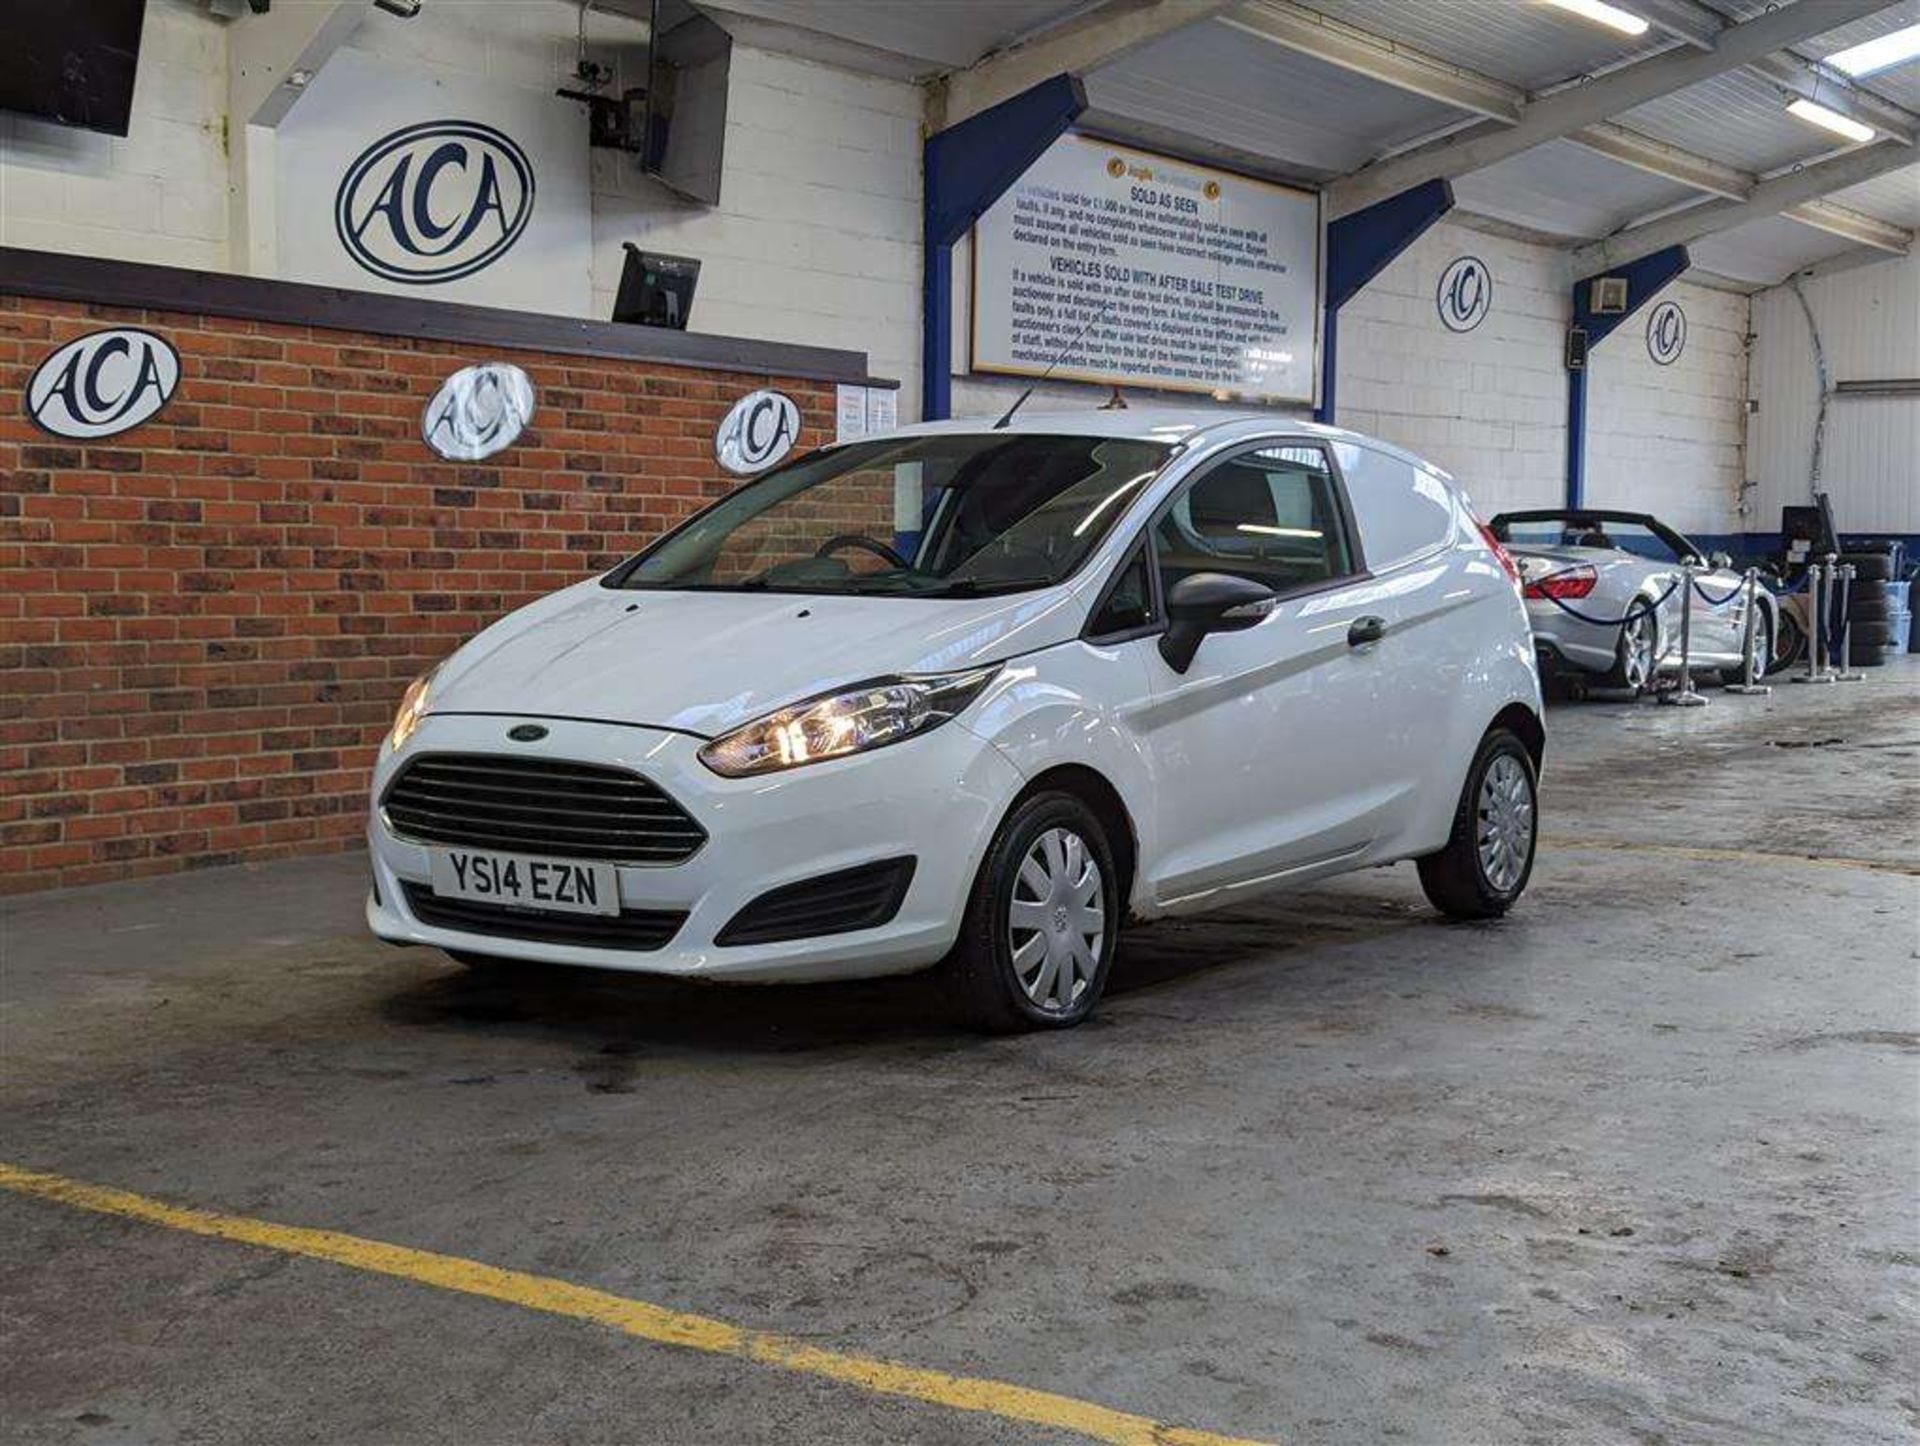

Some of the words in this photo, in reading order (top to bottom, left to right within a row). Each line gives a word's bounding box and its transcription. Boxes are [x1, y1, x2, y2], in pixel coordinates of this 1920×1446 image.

[354, 142, 509, 257] ACA
[1068, 209, 1083, 220] and
[1097, 215, 1136, 232] complaints
[1130, 186, 1156, 205] SOLD
[1159, 192, 1172, 208] AS
[1174, 195, 1198, 213] SEEN
[1013, 229, 1048, 245] declared
[1062, 238, 1074, 249] the
[1076, 240, 1096, 255] entry
[1014, 214, 1033, 226] must
[1036, 220, 1066, 232] assume
[1068, 225, 1078, 234] all
[1080, 227, 1111, 240] vehicles
[1012, 286, 1055, 301] auctioneer
[1057, 293, 1071, 303] and
[1118, 302, 1130, 312] the
[1131, 304, 1149, 317] entry
[1027, 272, 1055, 285] vehicle
[1066, 278, 1083, 290] sold
[1086, 281, 1101, 292] with
[1114, 286, 1130, 297] after
[1132, 289, 1146, 299] sale
[1148, 291, 1161, 301] test
[1050, 256, 1101, 278] VEHICLES
[1103, 265, 1130, 282] SOLD
[1132, 270, 1156, 287] WITH
[1159, 274, 1188, 292] AFTER
[1190, 279, 1213, 296] SALE
[1215, 283, 1236, 299] TEST
[1238, 287, 1264, 304] DRIVE
[1440, 266, 1484, 322] ACA
[1012, 302, 1035, 314] faults
[1064, 309, 1077, 319] full
[1079, 311, 1090, 321] list
[1649, 308, 1682, 356] ACA
[35, 336, 165, 426] ACA
[427, 371, 525, 448] ACA
[717, 397, 792, 464] ACA
[450, 852, 522, 897] YS14
[530, 862, 598, 906] EZN
